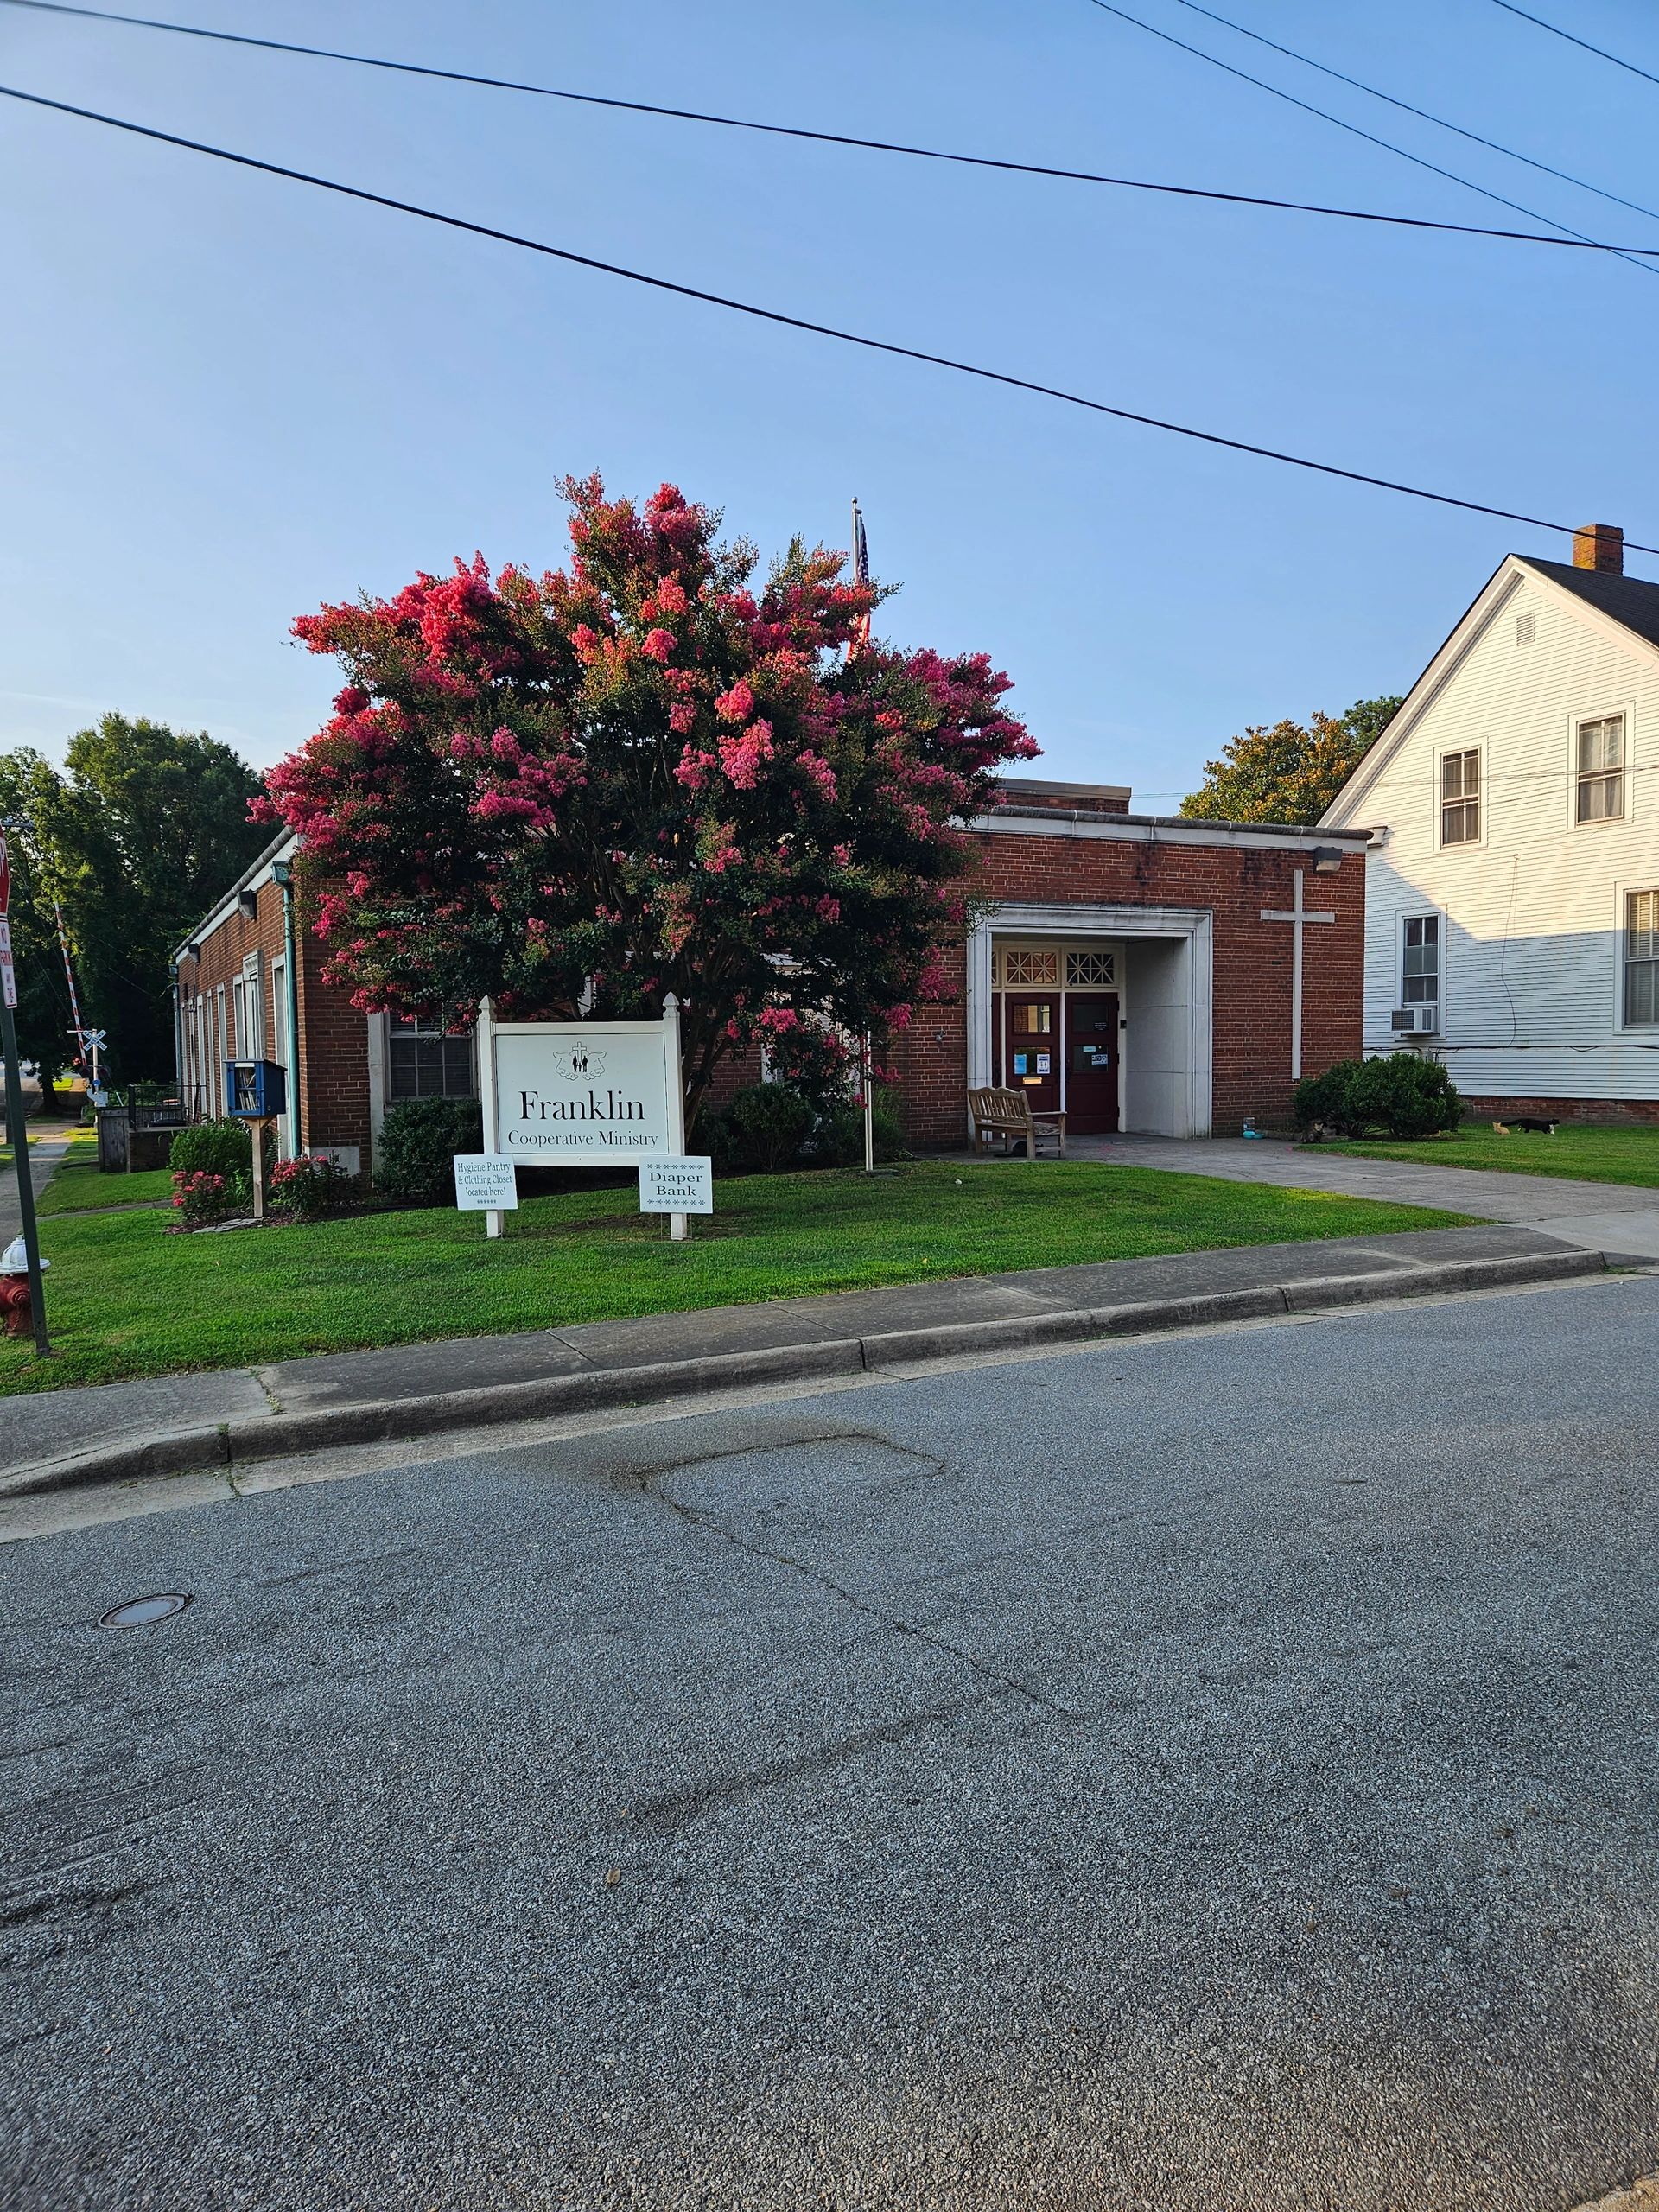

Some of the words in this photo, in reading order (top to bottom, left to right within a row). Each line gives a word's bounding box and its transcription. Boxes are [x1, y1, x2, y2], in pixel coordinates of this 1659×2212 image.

[518, 1090, 646, 1120] Franklin
[508, 1130, 594, 1147] Cooperative
[599, 1130, 658, 1148] Ministry
[457, 1162, 486, 1174] Hygiene
[486, 1162, 511, 1173] Pantry
[458, 1176, 463, 1185] &
[464, 1174, 492, 1185] Clothing
[492, 1174, 512, 1184] Closet
[649, 1172, 703, 1185] Diaper
[465, 1186, 488, 1197] located
[489, 1186, 506, 1196] here!
[657, 1185, 697, 1197] Bank
